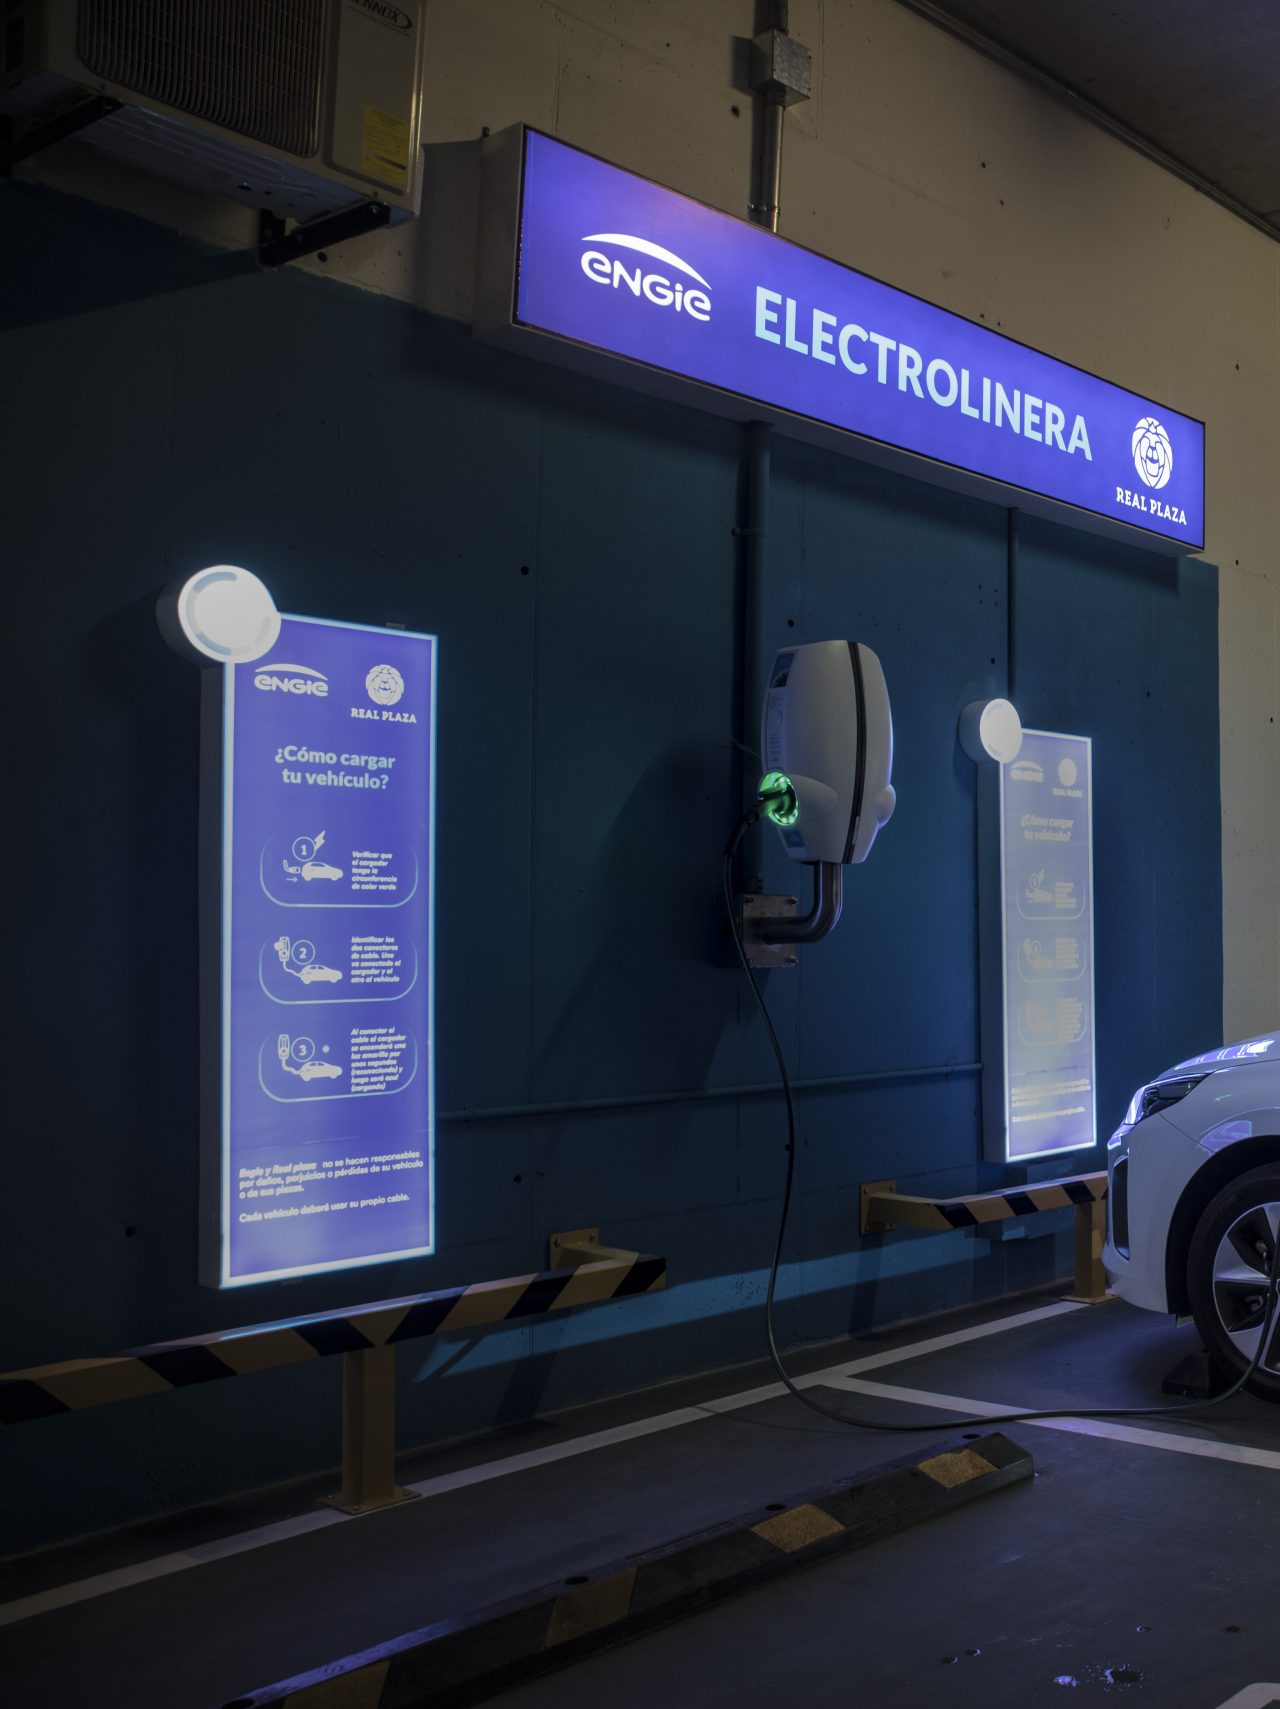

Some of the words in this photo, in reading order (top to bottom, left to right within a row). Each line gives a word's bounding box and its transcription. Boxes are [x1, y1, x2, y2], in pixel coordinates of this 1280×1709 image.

[755, 285, 1093, 461] ELECTROLINERA
[1116, 486, 1148, 512] REAL
[1149, 498, 1187, 526] PLAZA
[351, 707, 380, 720] REAL
[381, 710, 417, 723] PLAZA
[274, 745, 338, 764] ¿Cómo
[340, 753, 396, 770] cargar
[282, 767, 302, 784] tu
[305, 769, 389, 790] vehículo?
[301, 844, 307, 856] 1
[300, 947, 306, 958] 2
[299, 1044, 306, 1056] 3
[239, 1180, 255, 1190] por
[286, 1171, 326, 1185] perjuicios
[334, 1166, 369, 1178] pérdidas
[370, 1165, 380, 1173] de
[392, 1159, 424, 1170] vehículo
[264, 1167, 272, 1177] y
[345, 1157, 369, 1166] hacen
[370, 1150, 420, 1163] responsables
[239, 1191, 246, 1199] o
[247, 1188, 258, 1198] de
[260, 1188, 274, 1197] sus
[239, 1211, 263, 1223] Cada
[263, 1206, 299, 1219] vehículo
[300, 1202, 330, 1215] deberá
[330, 1202, 348, 1211] usar
[360, 1195, 386, 1208] propio
[387, 1193, 410, 1203] cable.
